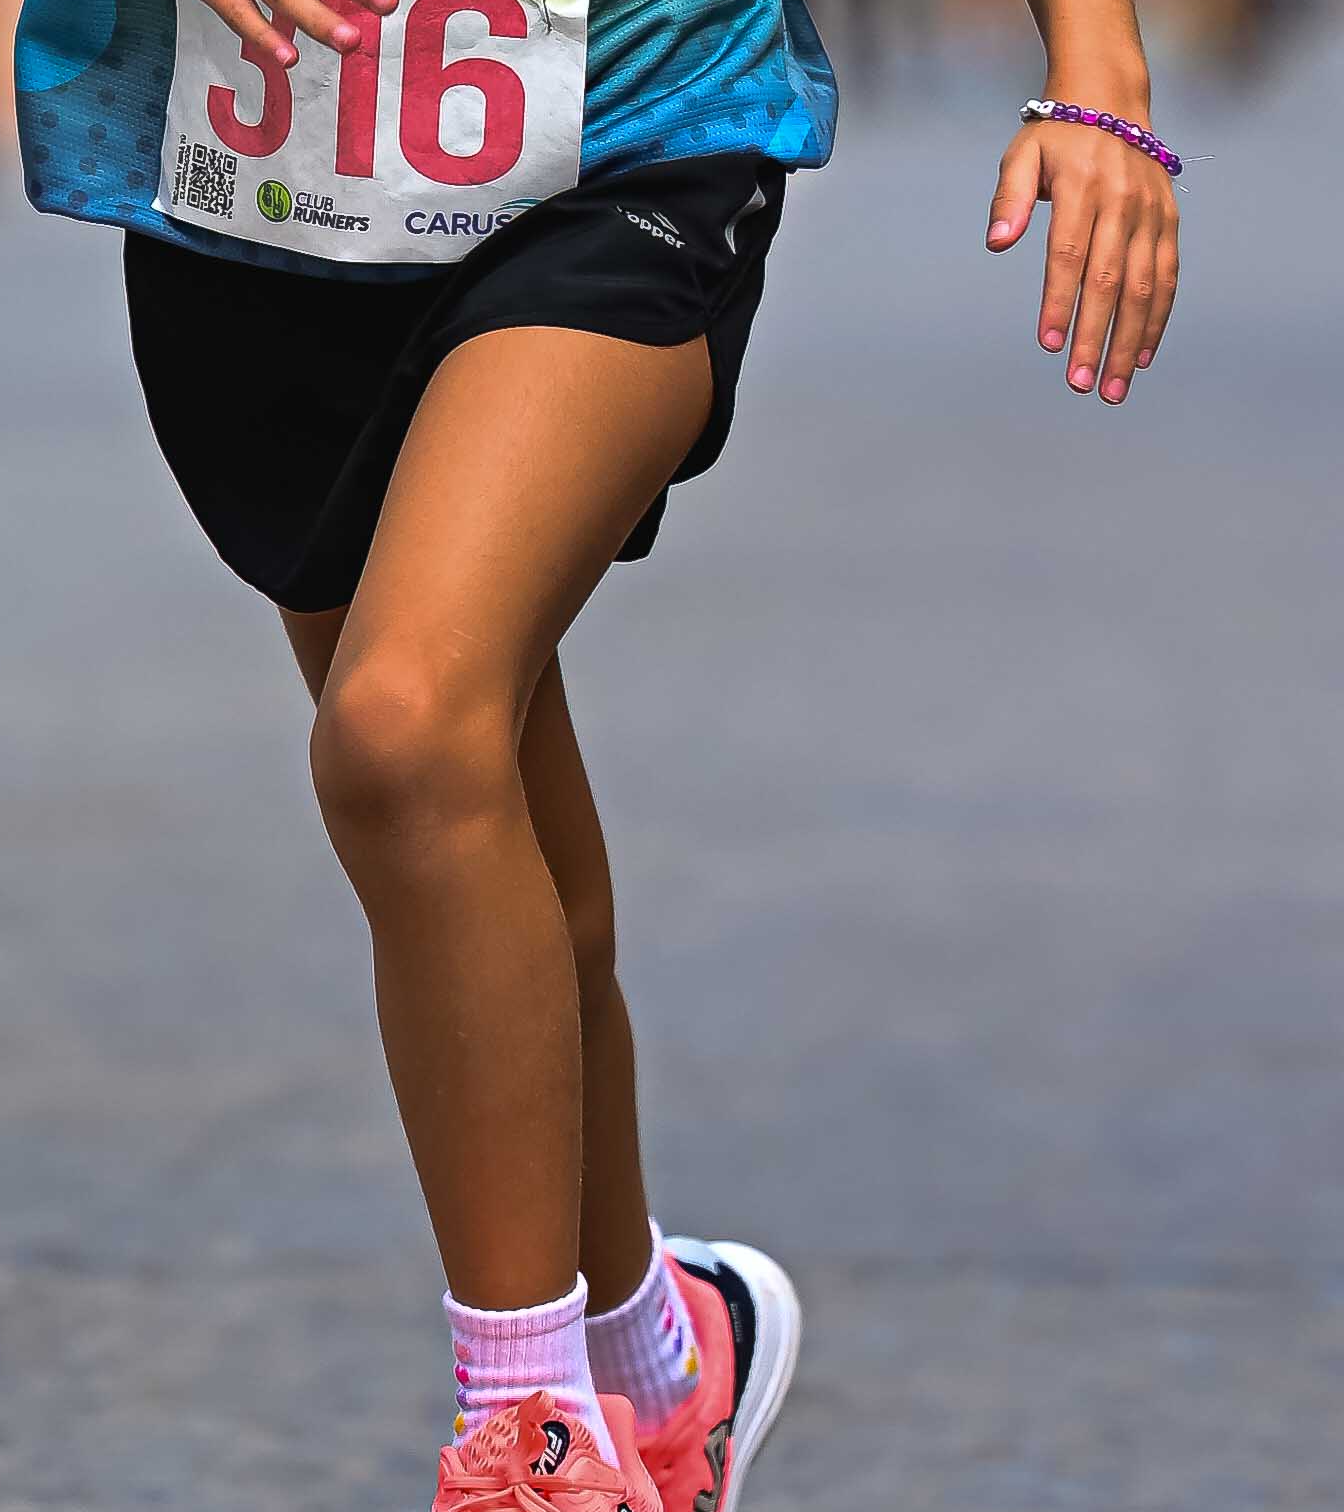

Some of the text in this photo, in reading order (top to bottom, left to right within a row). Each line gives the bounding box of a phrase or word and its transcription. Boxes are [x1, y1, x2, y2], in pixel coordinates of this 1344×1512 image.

[295, 191, 334, 212] CLUB
[293, 205, 370, 232] RUNNER'S
[617, 205, 686, 249] opper
